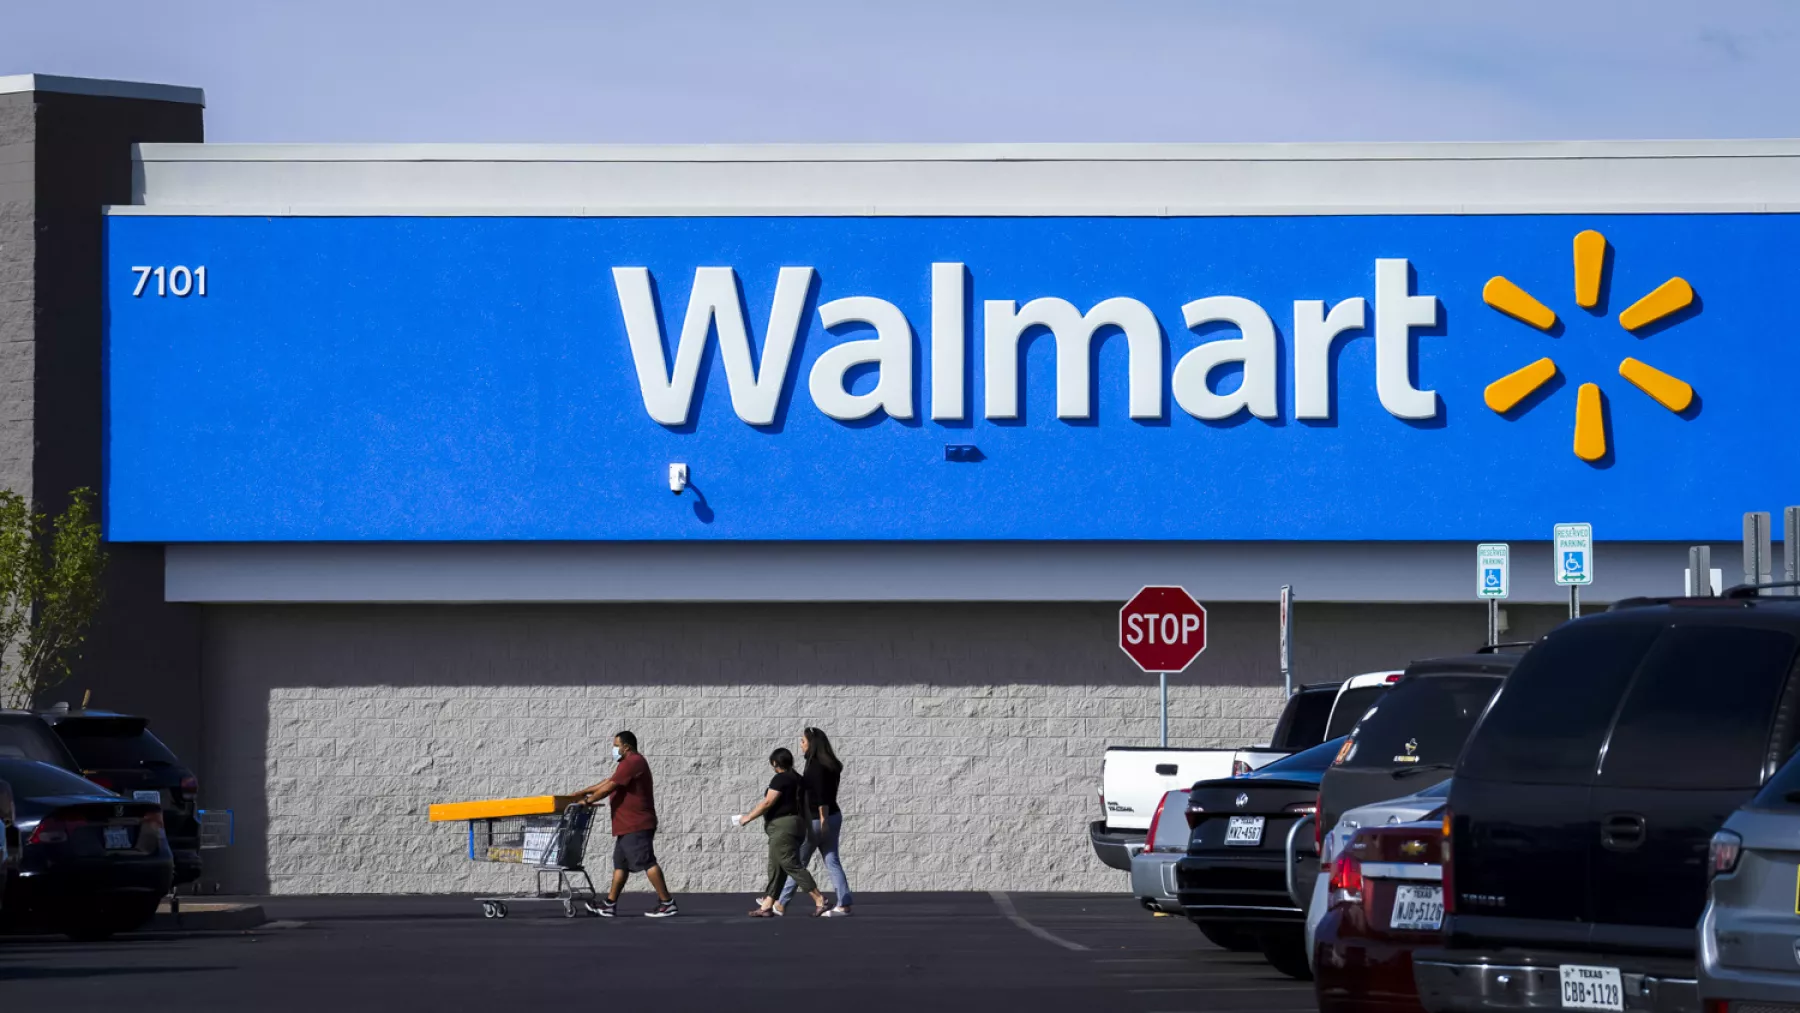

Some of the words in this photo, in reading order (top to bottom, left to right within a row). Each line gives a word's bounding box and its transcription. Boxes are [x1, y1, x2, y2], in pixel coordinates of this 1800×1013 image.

[131, 265, 205, 296] 7101
[612, 258, 1437, 426] Walmart
[1557, 529, 1588, 537] RESERVED
[1560, 540, 1586, 548] PARKING
[1480, 549, 1506, 557] RESERVED
[1126, 613, 1200, 645] STOP
[1413, 889, 1433, 899] TEXAS
[1578, 969, 1603, 979] TEXAS
